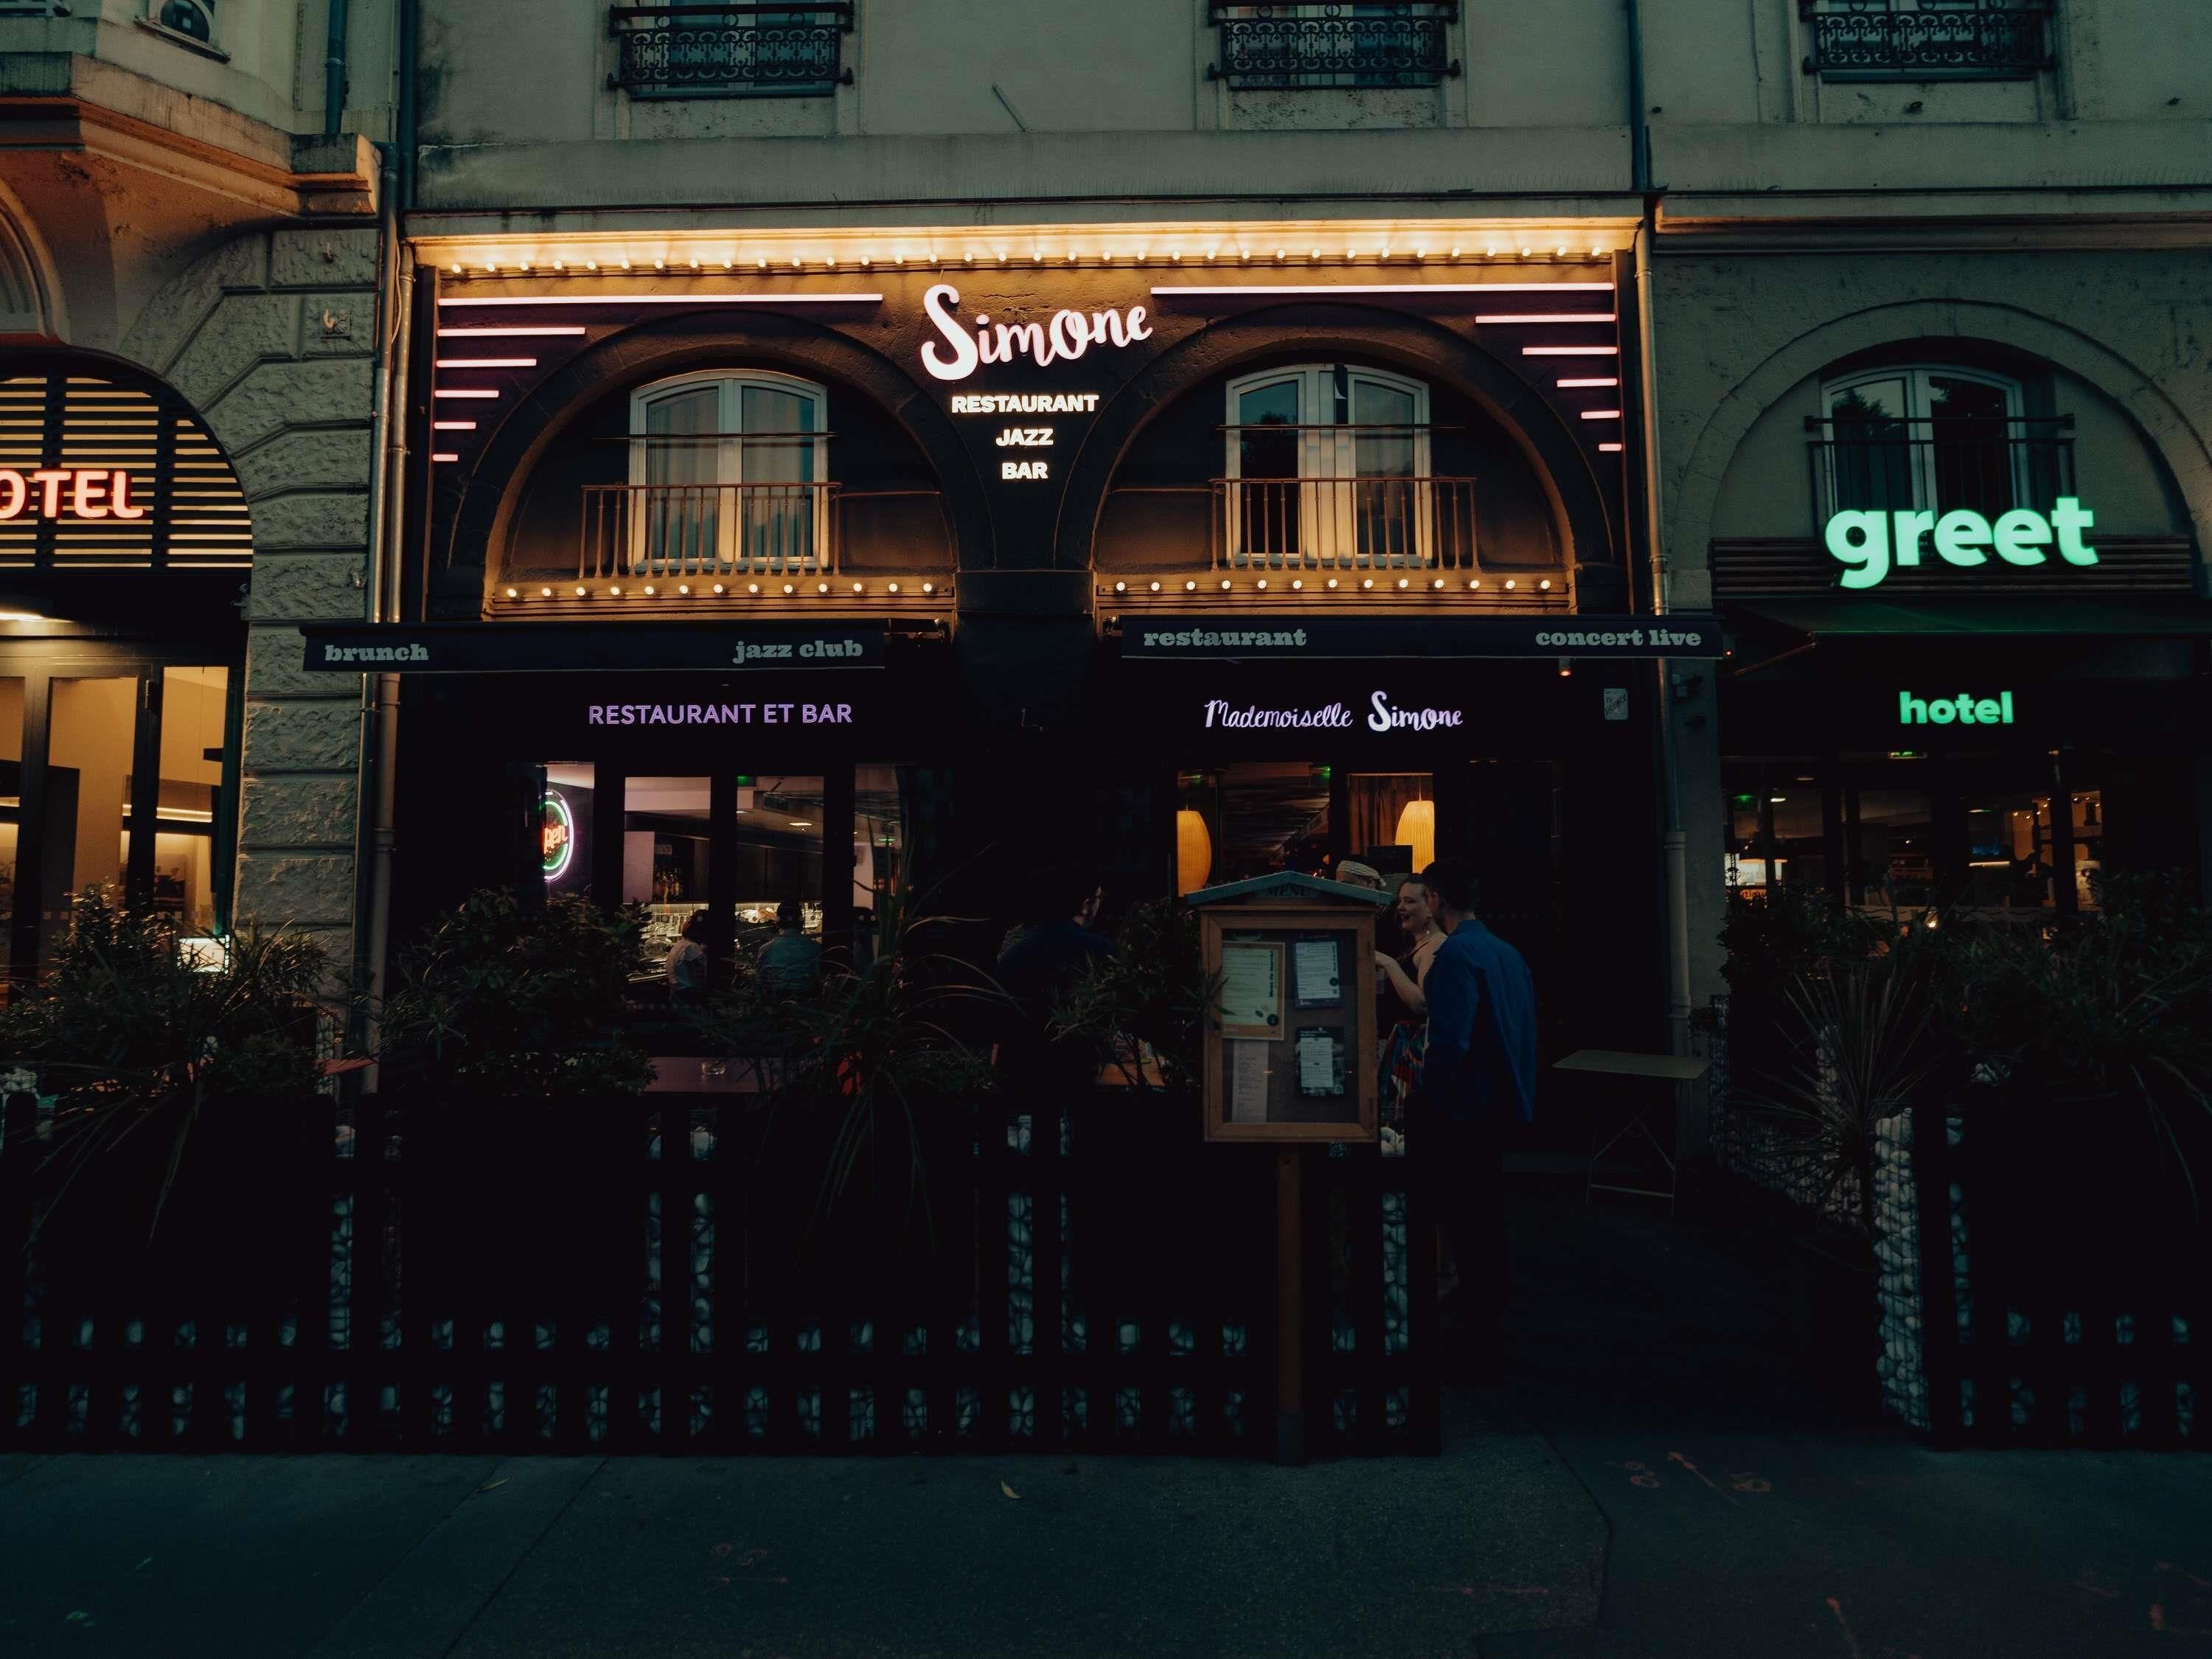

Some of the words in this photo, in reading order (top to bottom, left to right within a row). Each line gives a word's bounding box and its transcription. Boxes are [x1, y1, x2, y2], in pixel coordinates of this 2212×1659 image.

[920, 284, 1153, 380] Simone
[951, 394, 1099, 413] RESTAURANT
[995, 428, 1054, 446] JAZZ
[1001, 462, 1048, 479] BAR
[1824, 496, 2099, 589] greet
[1144, 628, 1307, 647] restaurant
[1535, 628, 1644, 646] concert
[1649, 628, 1701, 647] live
[324, 643, 429, 661] brunch
[732, 640, 792, 664] jazz
[799, 639, 863, 658] club
[588, 703, 756, 725] RESTAURANT
[763, 703, 795, 723] ET
[801, 703, 853, 723] BAR
[1203, 699, 1354, 728] Mademoiselle
[1366, 690, 1464, 732] Simone
[1899, 691, 2014, 724] hotel
[543, 825, 568, 855] pen
